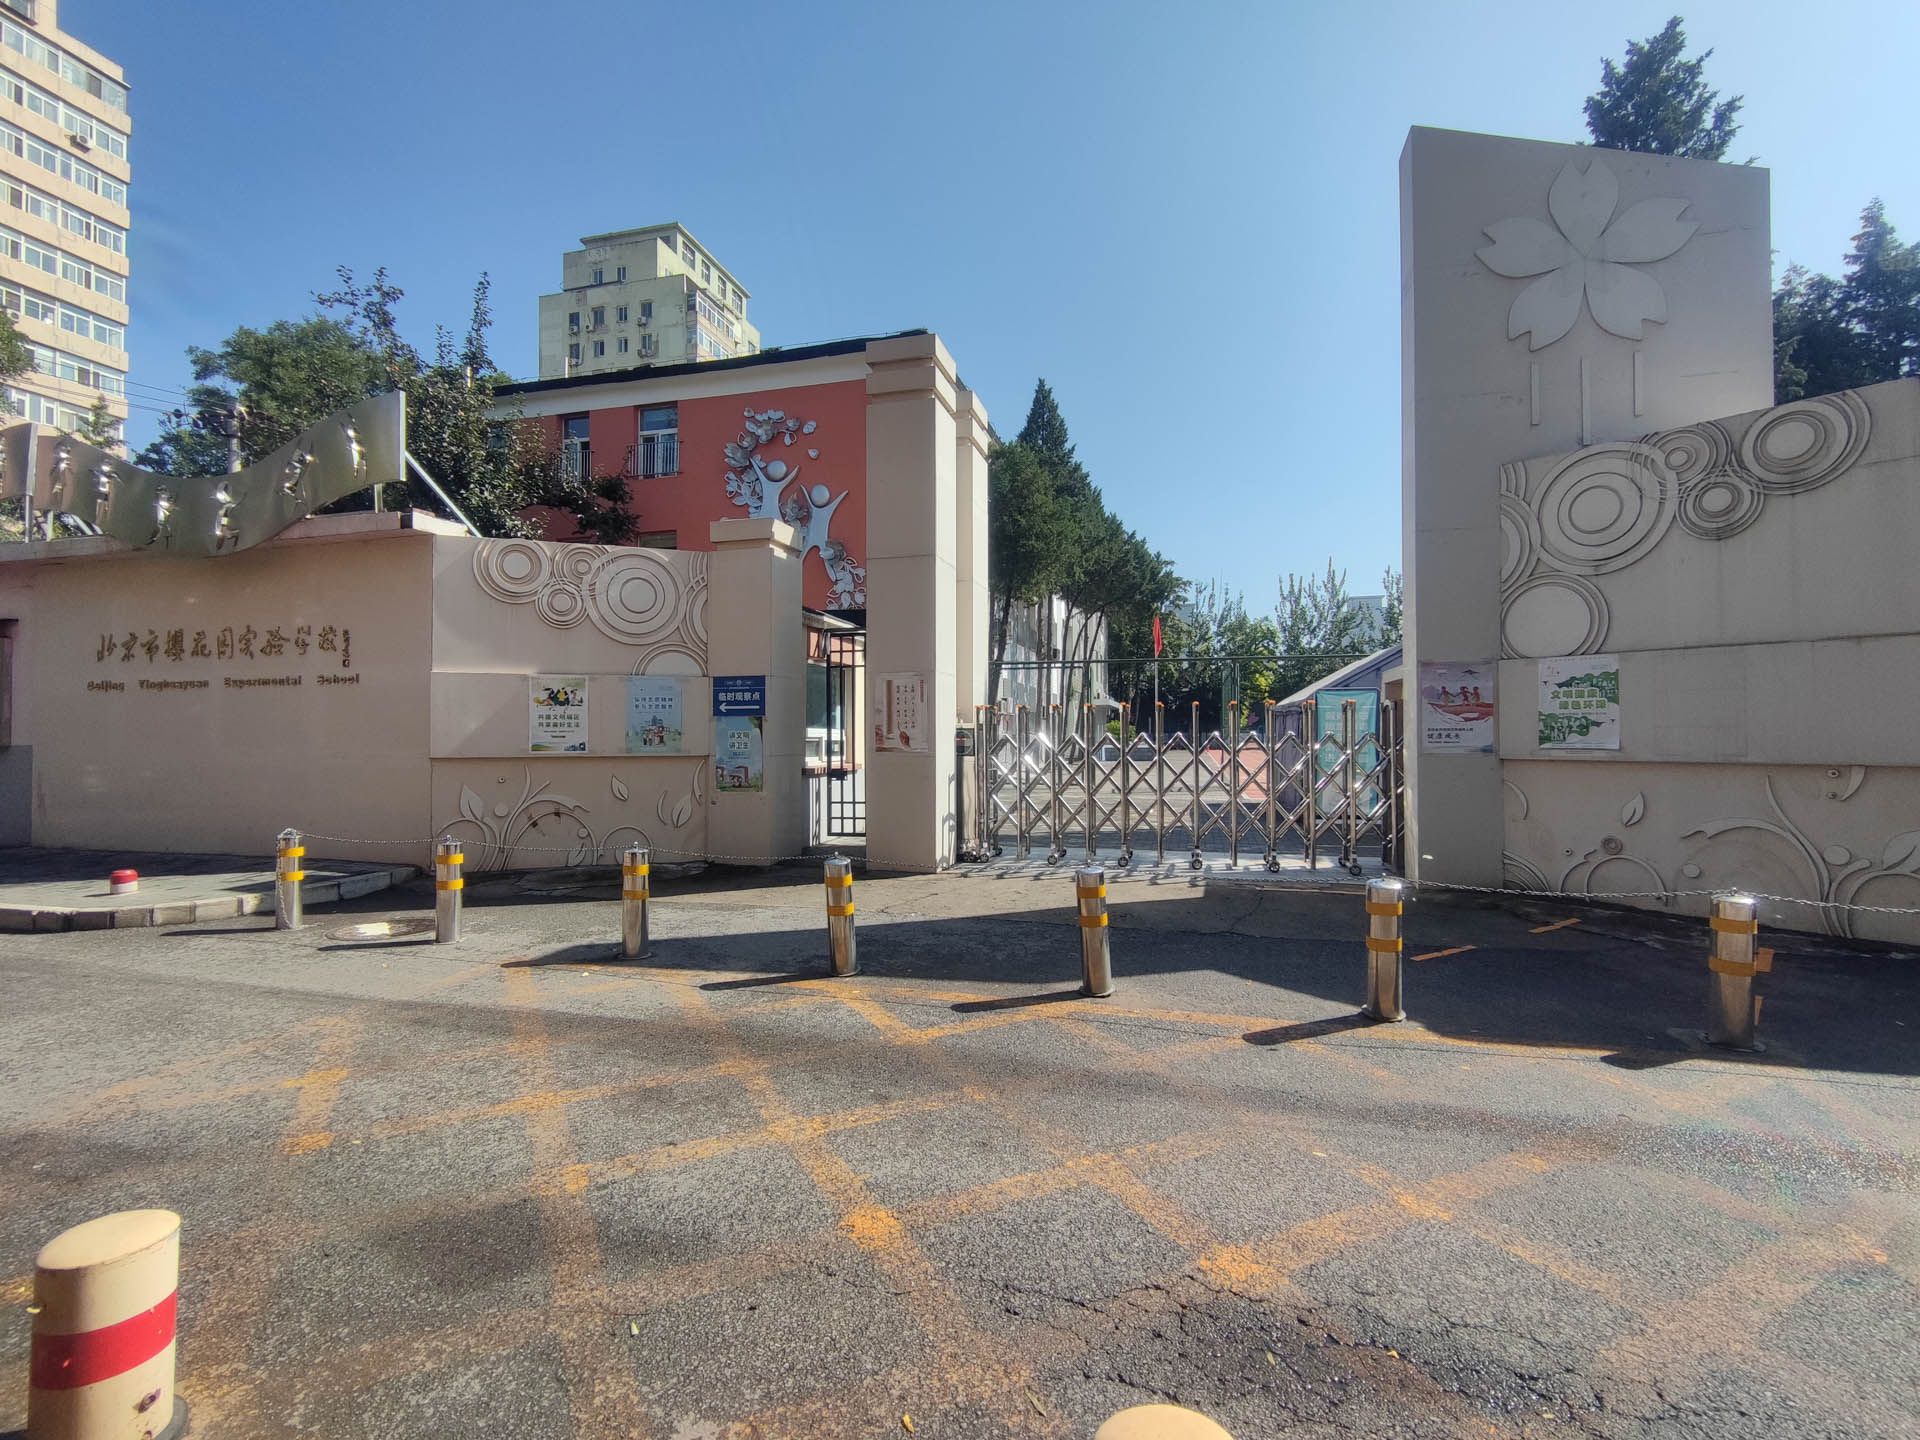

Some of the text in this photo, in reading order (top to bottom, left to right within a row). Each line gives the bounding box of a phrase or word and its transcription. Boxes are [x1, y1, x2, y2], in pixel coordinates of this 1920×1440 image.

[86, 680, 125, 692] Beijing
[223, 674, 303, 689] Experimental
[316, 672, 360, 685] School
[718, 691, 761, 702] 临时观察点
